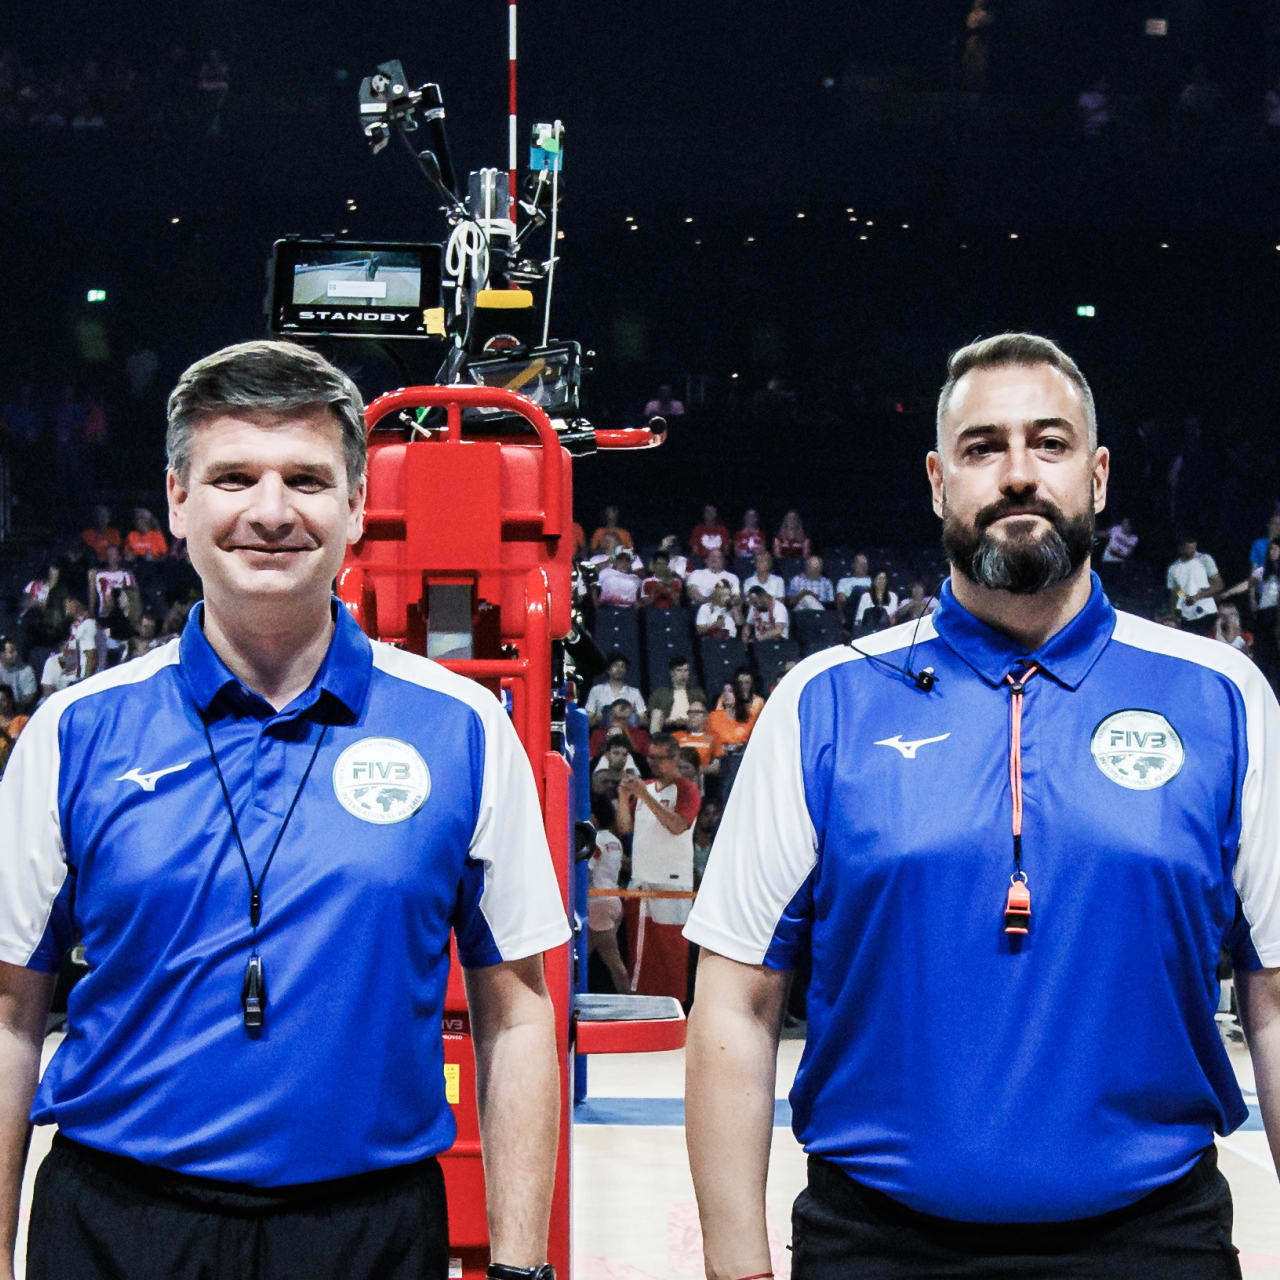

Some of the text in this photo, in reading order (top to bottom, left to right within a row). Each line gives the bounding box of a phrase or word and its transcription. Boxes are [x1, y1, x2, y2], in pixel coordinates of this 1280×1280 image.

[298, 311, 410, 322] STANDBY
[1110, 730, 1167, 748] FIVB
[352, 761, 411, 780] FIVB
